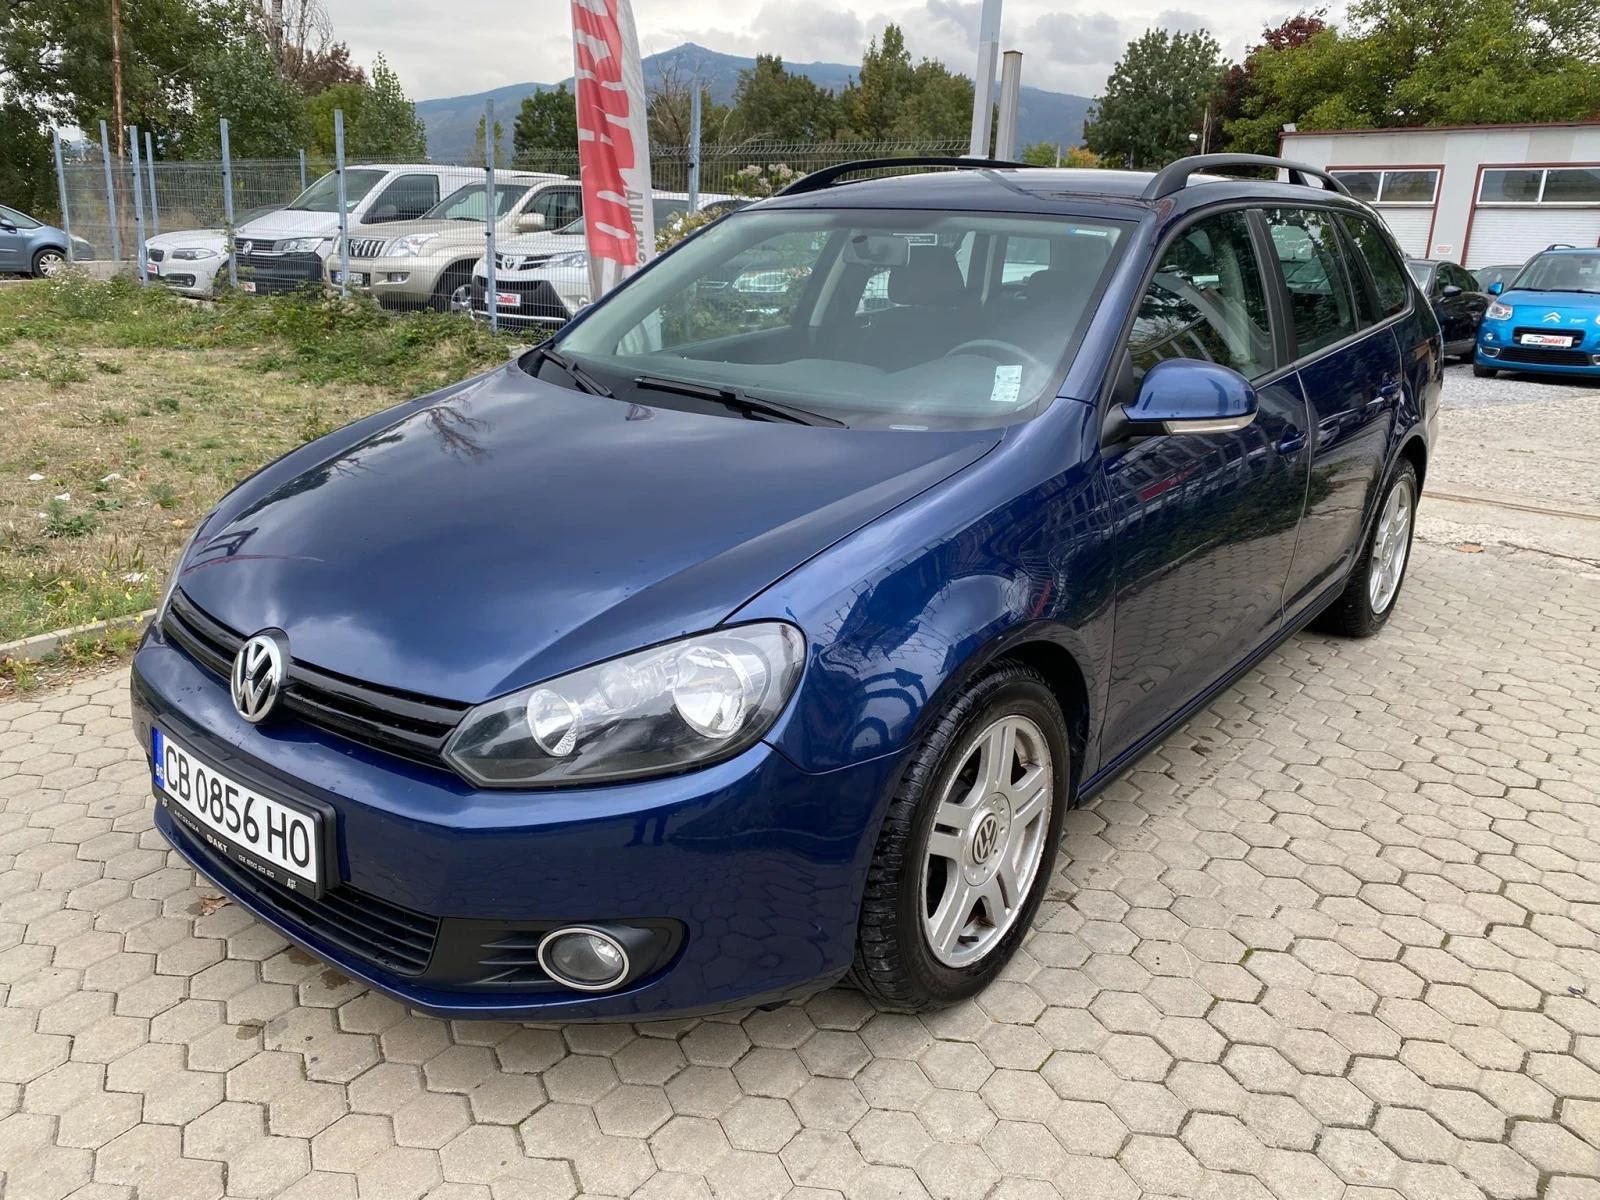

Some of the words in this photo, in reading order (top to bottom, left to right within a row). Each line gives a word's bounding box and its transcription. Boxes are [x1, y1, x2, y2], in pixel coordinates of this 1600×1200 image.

[155, 763, 164, 780] BG
[166, 745, 191, 801] CB
[195, 767, 260, 844] 0856
[266, 805, 310, 868] HO
